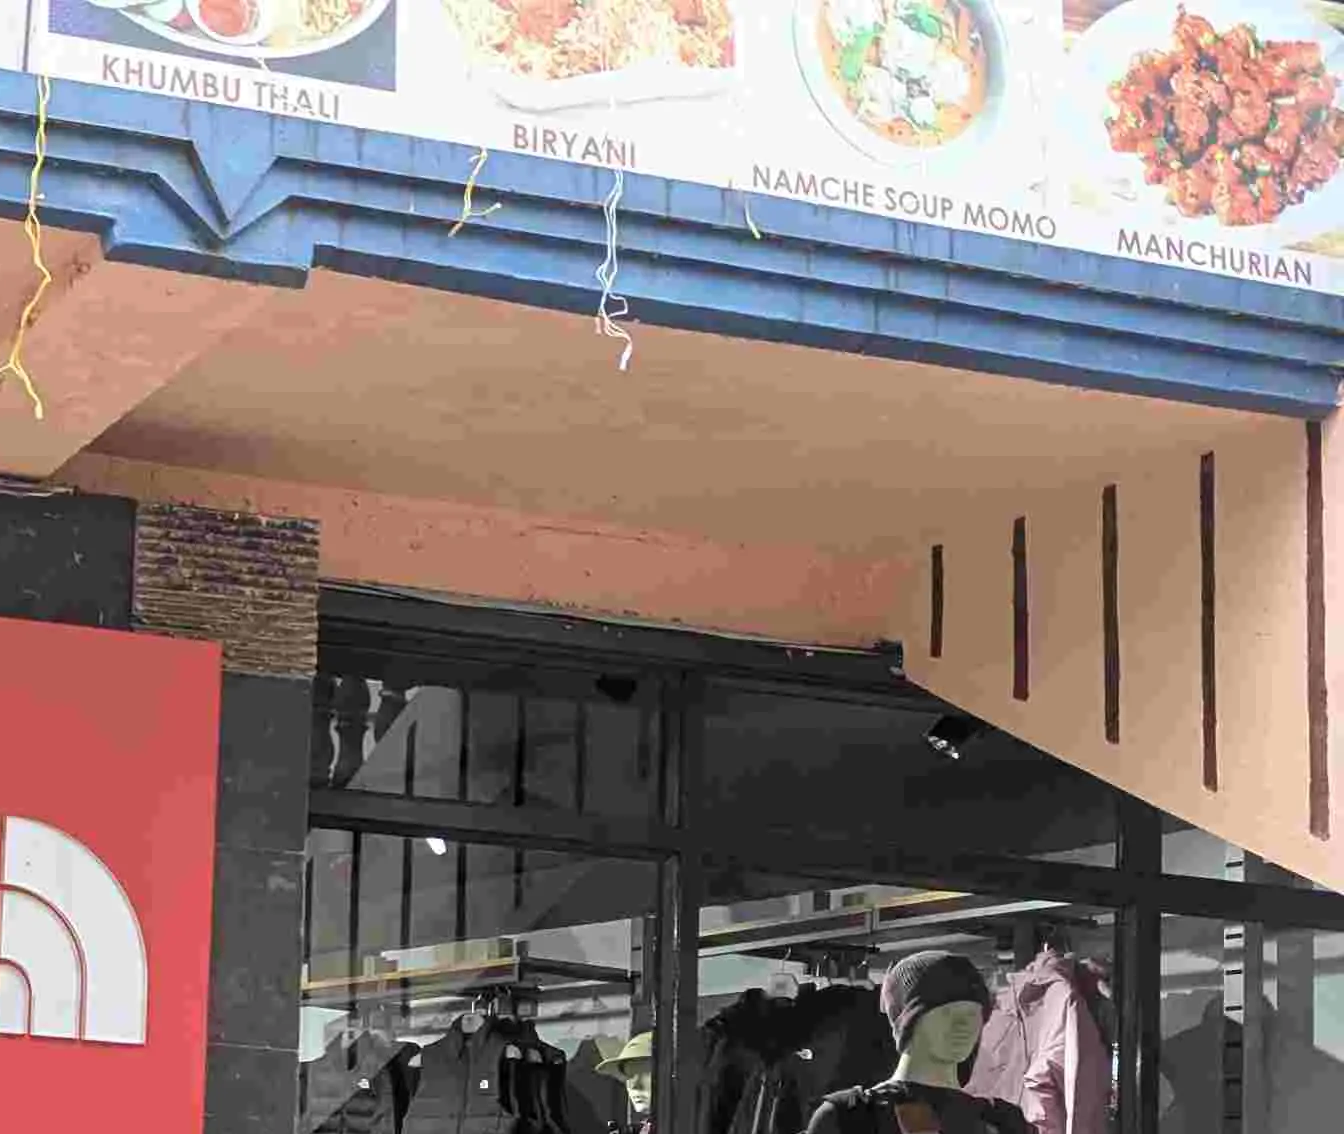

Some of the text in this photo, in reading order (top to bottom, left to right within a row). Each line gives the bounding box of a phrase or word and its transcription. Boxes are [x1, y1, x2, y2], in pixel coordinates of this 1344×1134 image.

[101, 54, 342, 122] KHUMBU THALI
[512, 123, 638, 168] BIRYANI
[752, 164, 1059, 241] NAMCHE SOUP MOMO
[1117, 229, 1313, 285] MANCHURIAN
